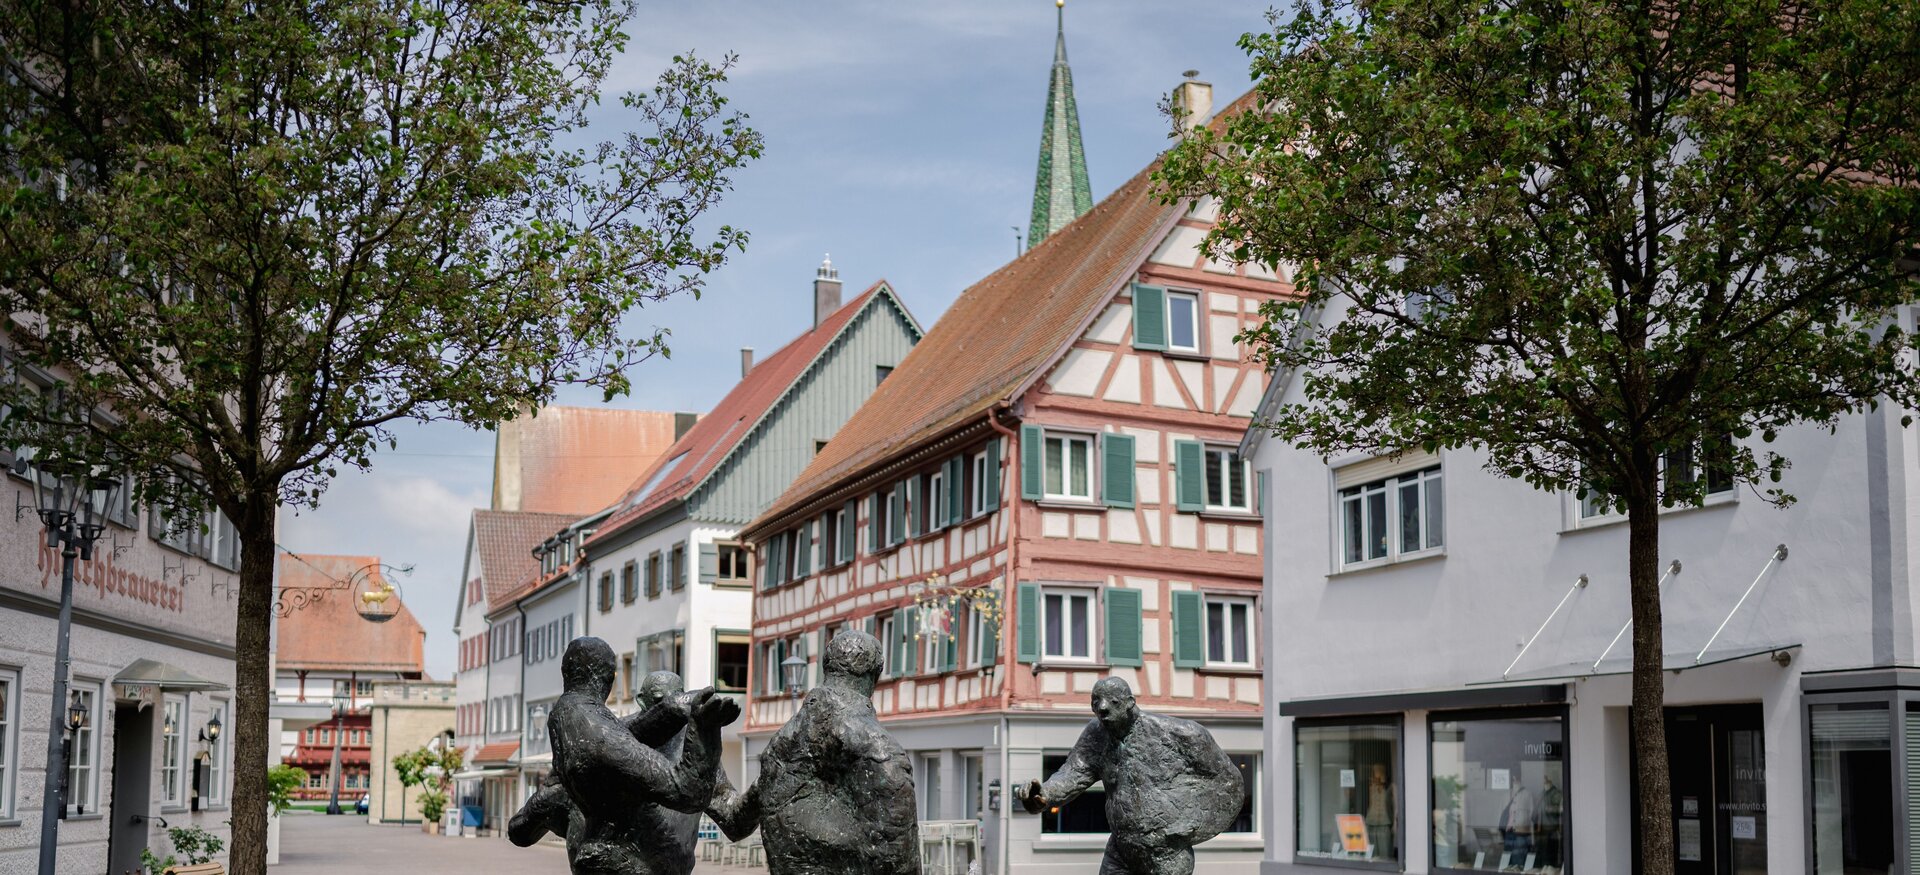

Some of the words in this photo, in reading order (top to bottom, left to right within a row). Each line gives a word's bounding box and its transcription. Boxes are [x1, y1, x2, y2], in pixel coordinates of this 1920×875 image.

[38, 528, 184, 613] Hischbrauerei
[1524, 740, 1552, 755] invito
[1719, 801, 1767, 811] www.invito.s
